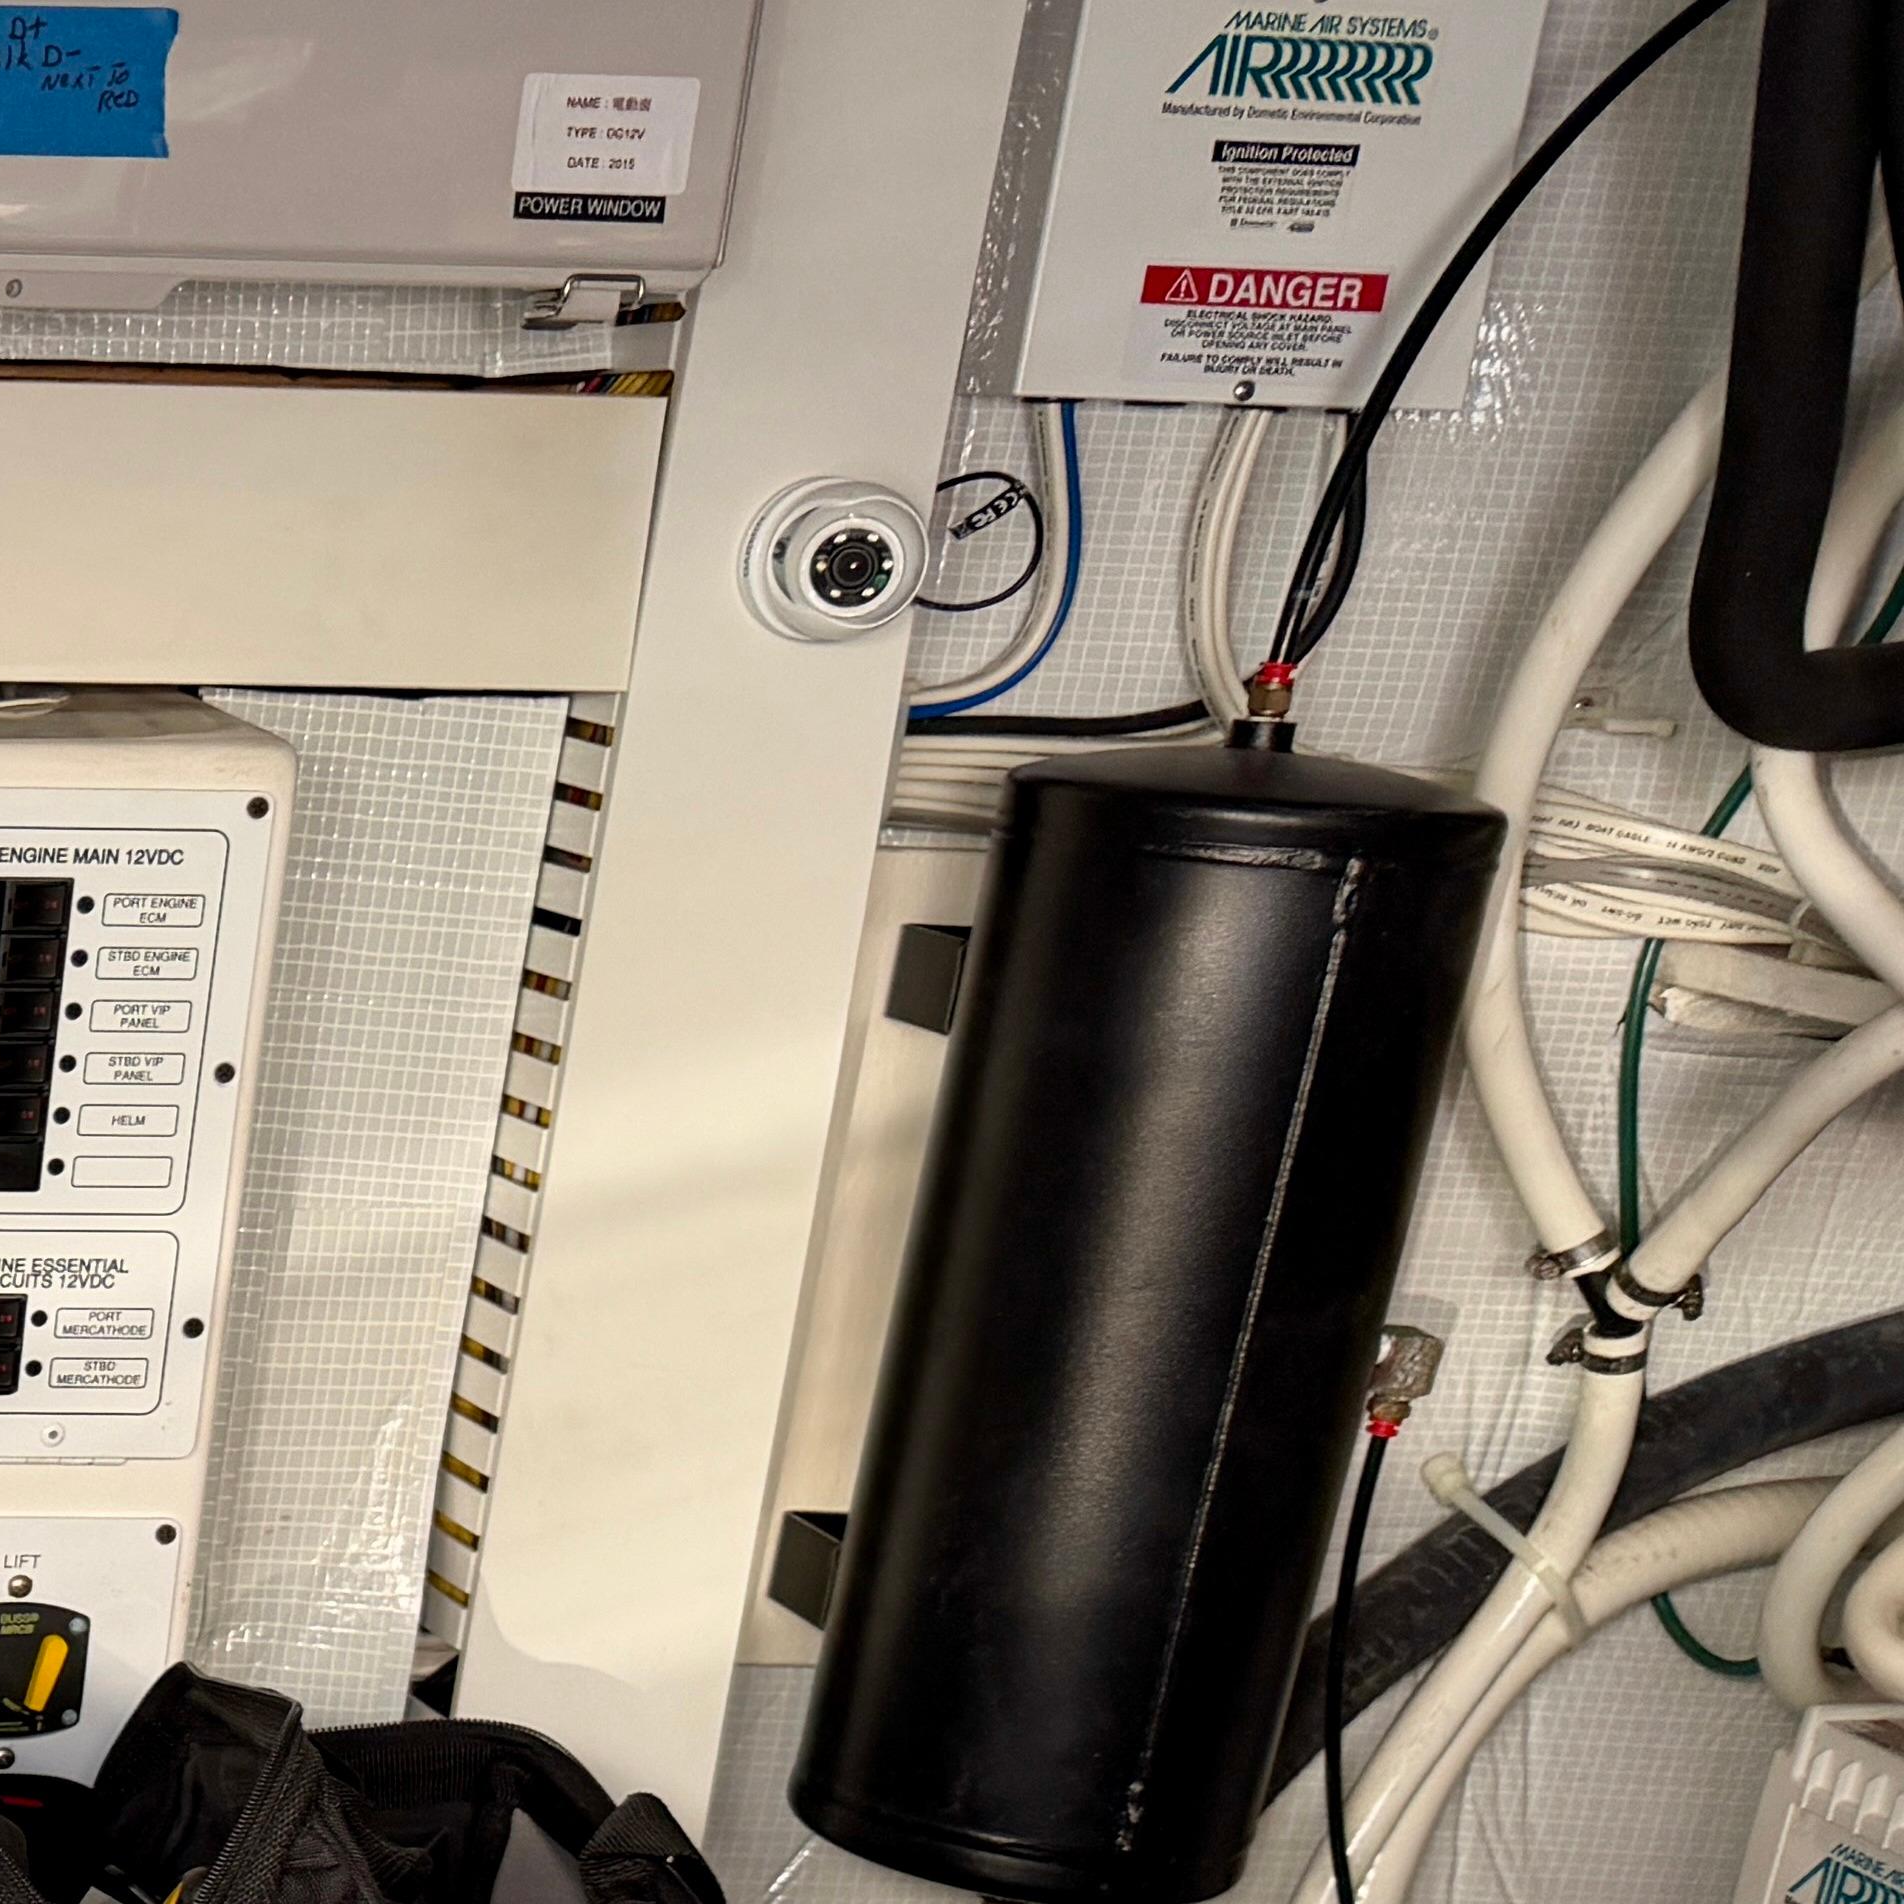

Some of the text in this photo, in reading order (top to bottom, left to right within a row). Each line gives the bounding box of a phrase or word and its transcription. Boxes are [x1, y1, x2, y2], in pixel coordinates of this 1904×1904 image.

[1224, 10, 1427, 39] MARINE AIR SYSTEMS
[566, 127, 597, 139] TYPE
[1221, 142, 1354, 164] Ignition Protected
[567, 157, 599, 168] DATE
[519, 196, 662, 218] POWER WINDOW
[1207, 273, 1363, 309] DANGER
[72, 848, 121, 865] MAIN
[125, 848, 184, 866] 12VDC
[113, 897, 144, 910] PORT
[138, 911, 167, 925] ECM
[111, 1114, 146, 1128] HELM
[32, 1258, 129, 1275] ESSENTIAL
[59, 1274, 116, 1289] 12VDC
[88, 1310, 122, 1323] PORT
[3, 1554, 41, 1570] LIFT
